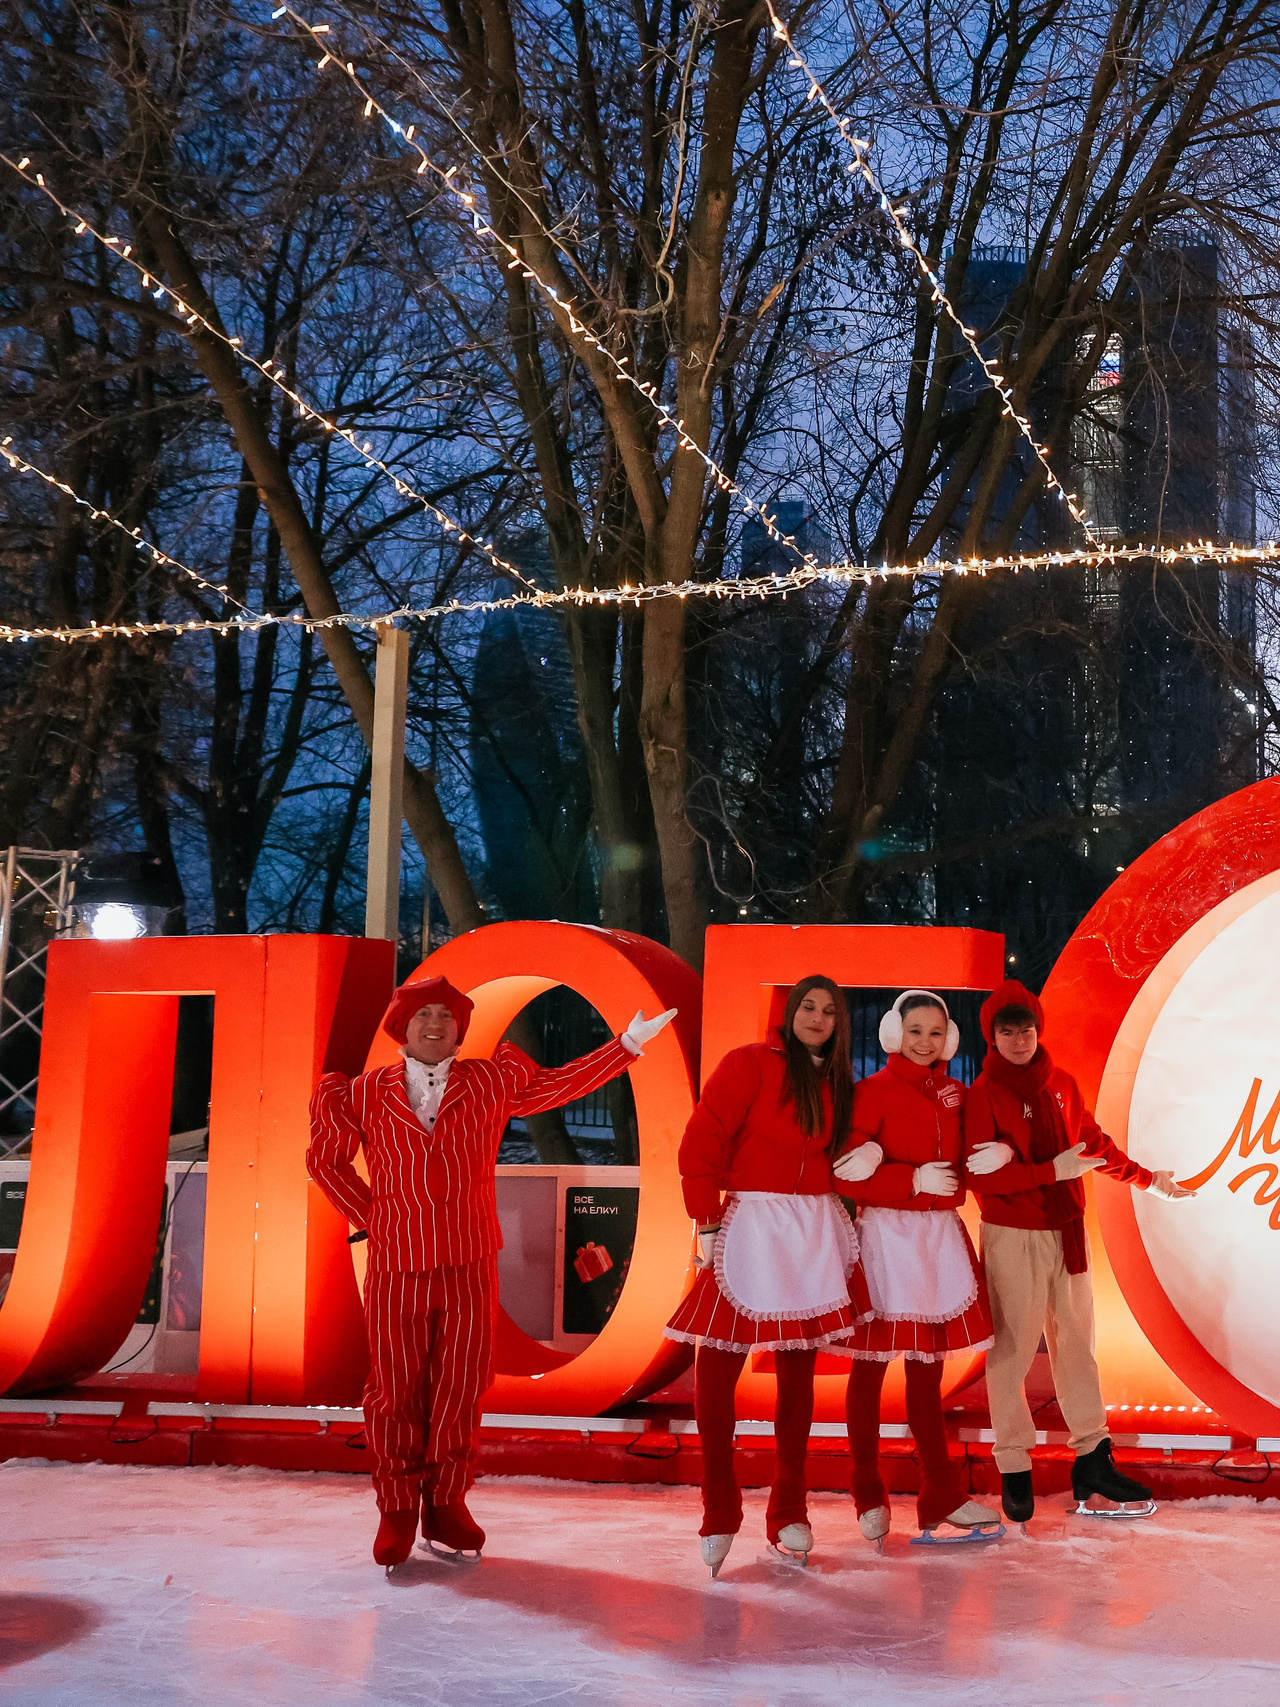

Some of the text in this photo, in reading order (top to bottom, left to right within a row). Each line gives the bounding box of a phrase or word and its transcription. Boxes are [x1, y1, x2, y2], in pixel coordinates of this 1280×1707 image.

[574, 1196, 594, 1204] ВСЕ
[573, 1206, 619, 1215] НА ЕЛКУ!
